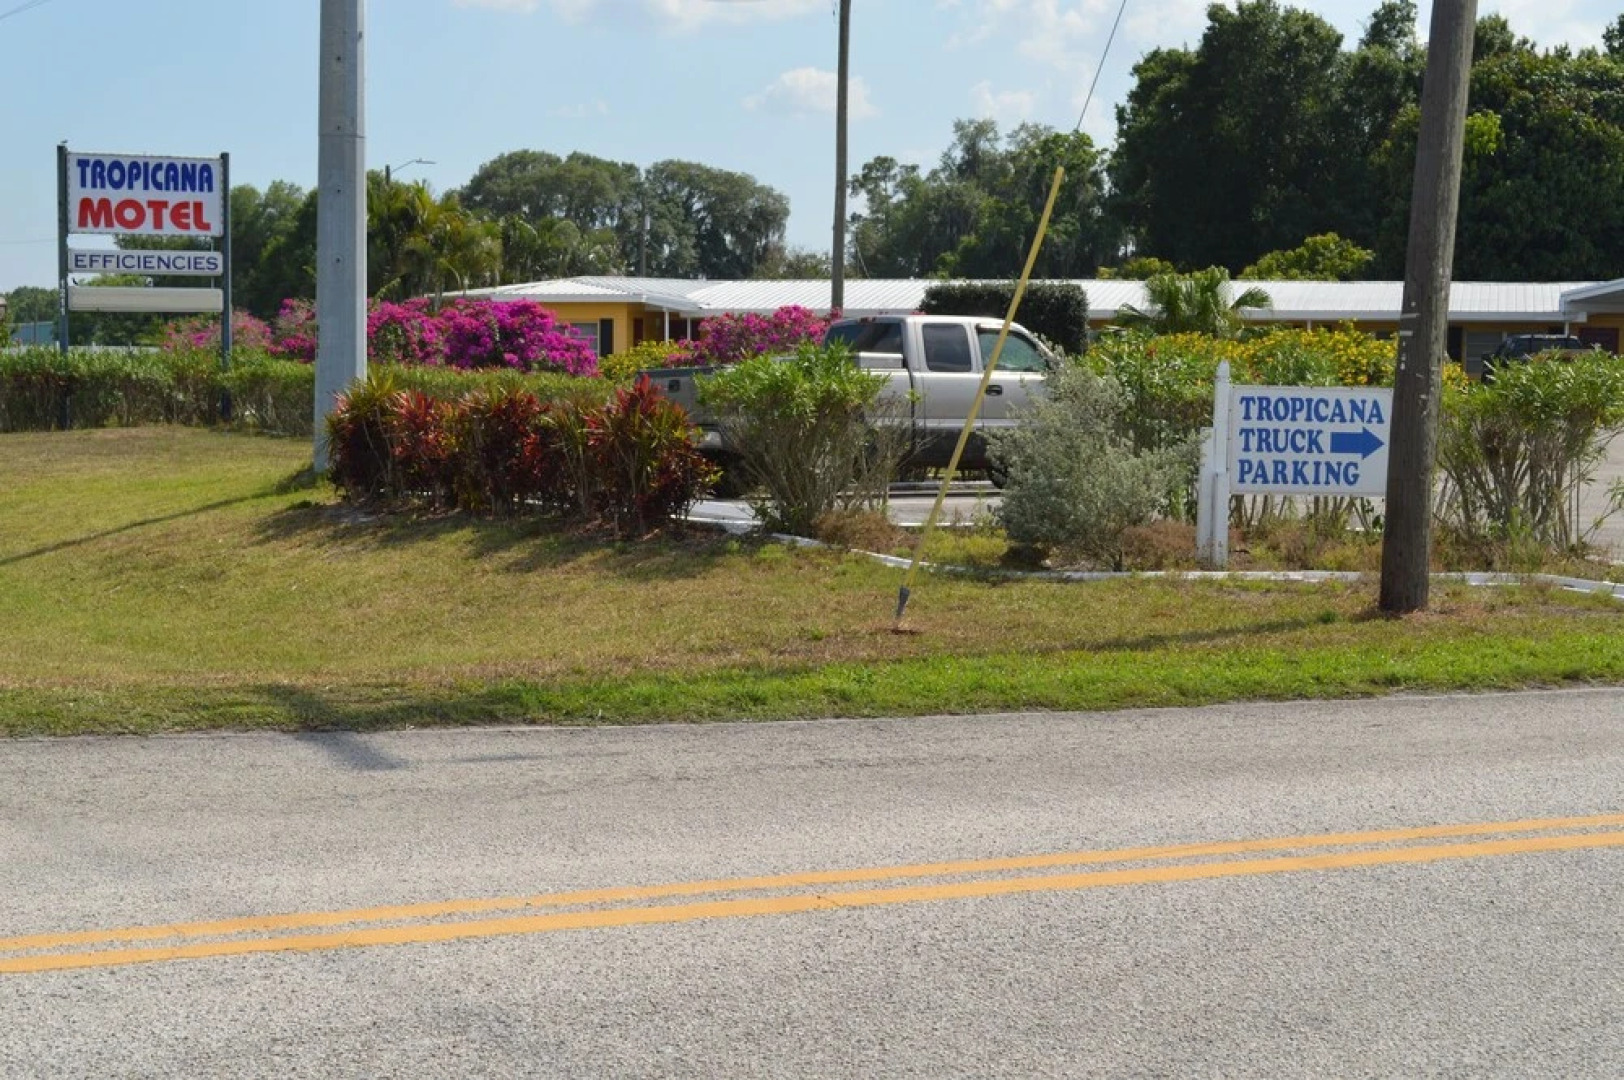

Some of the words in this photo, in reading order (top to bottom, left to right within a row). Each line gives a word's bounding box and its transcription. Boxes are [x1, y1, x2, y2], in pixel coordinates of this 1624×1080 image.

[77, 159, 214, 192] TROPICANA
[77, 197, 212, 232] MOTEL
[74, 254, 219, 270] EFFICIENCIES
[1239, 396, 1385, 424] TROPICANA
[1239, 428, 1324, 454] TRUCK
[1238, 459, 1360, 486] PARKING
